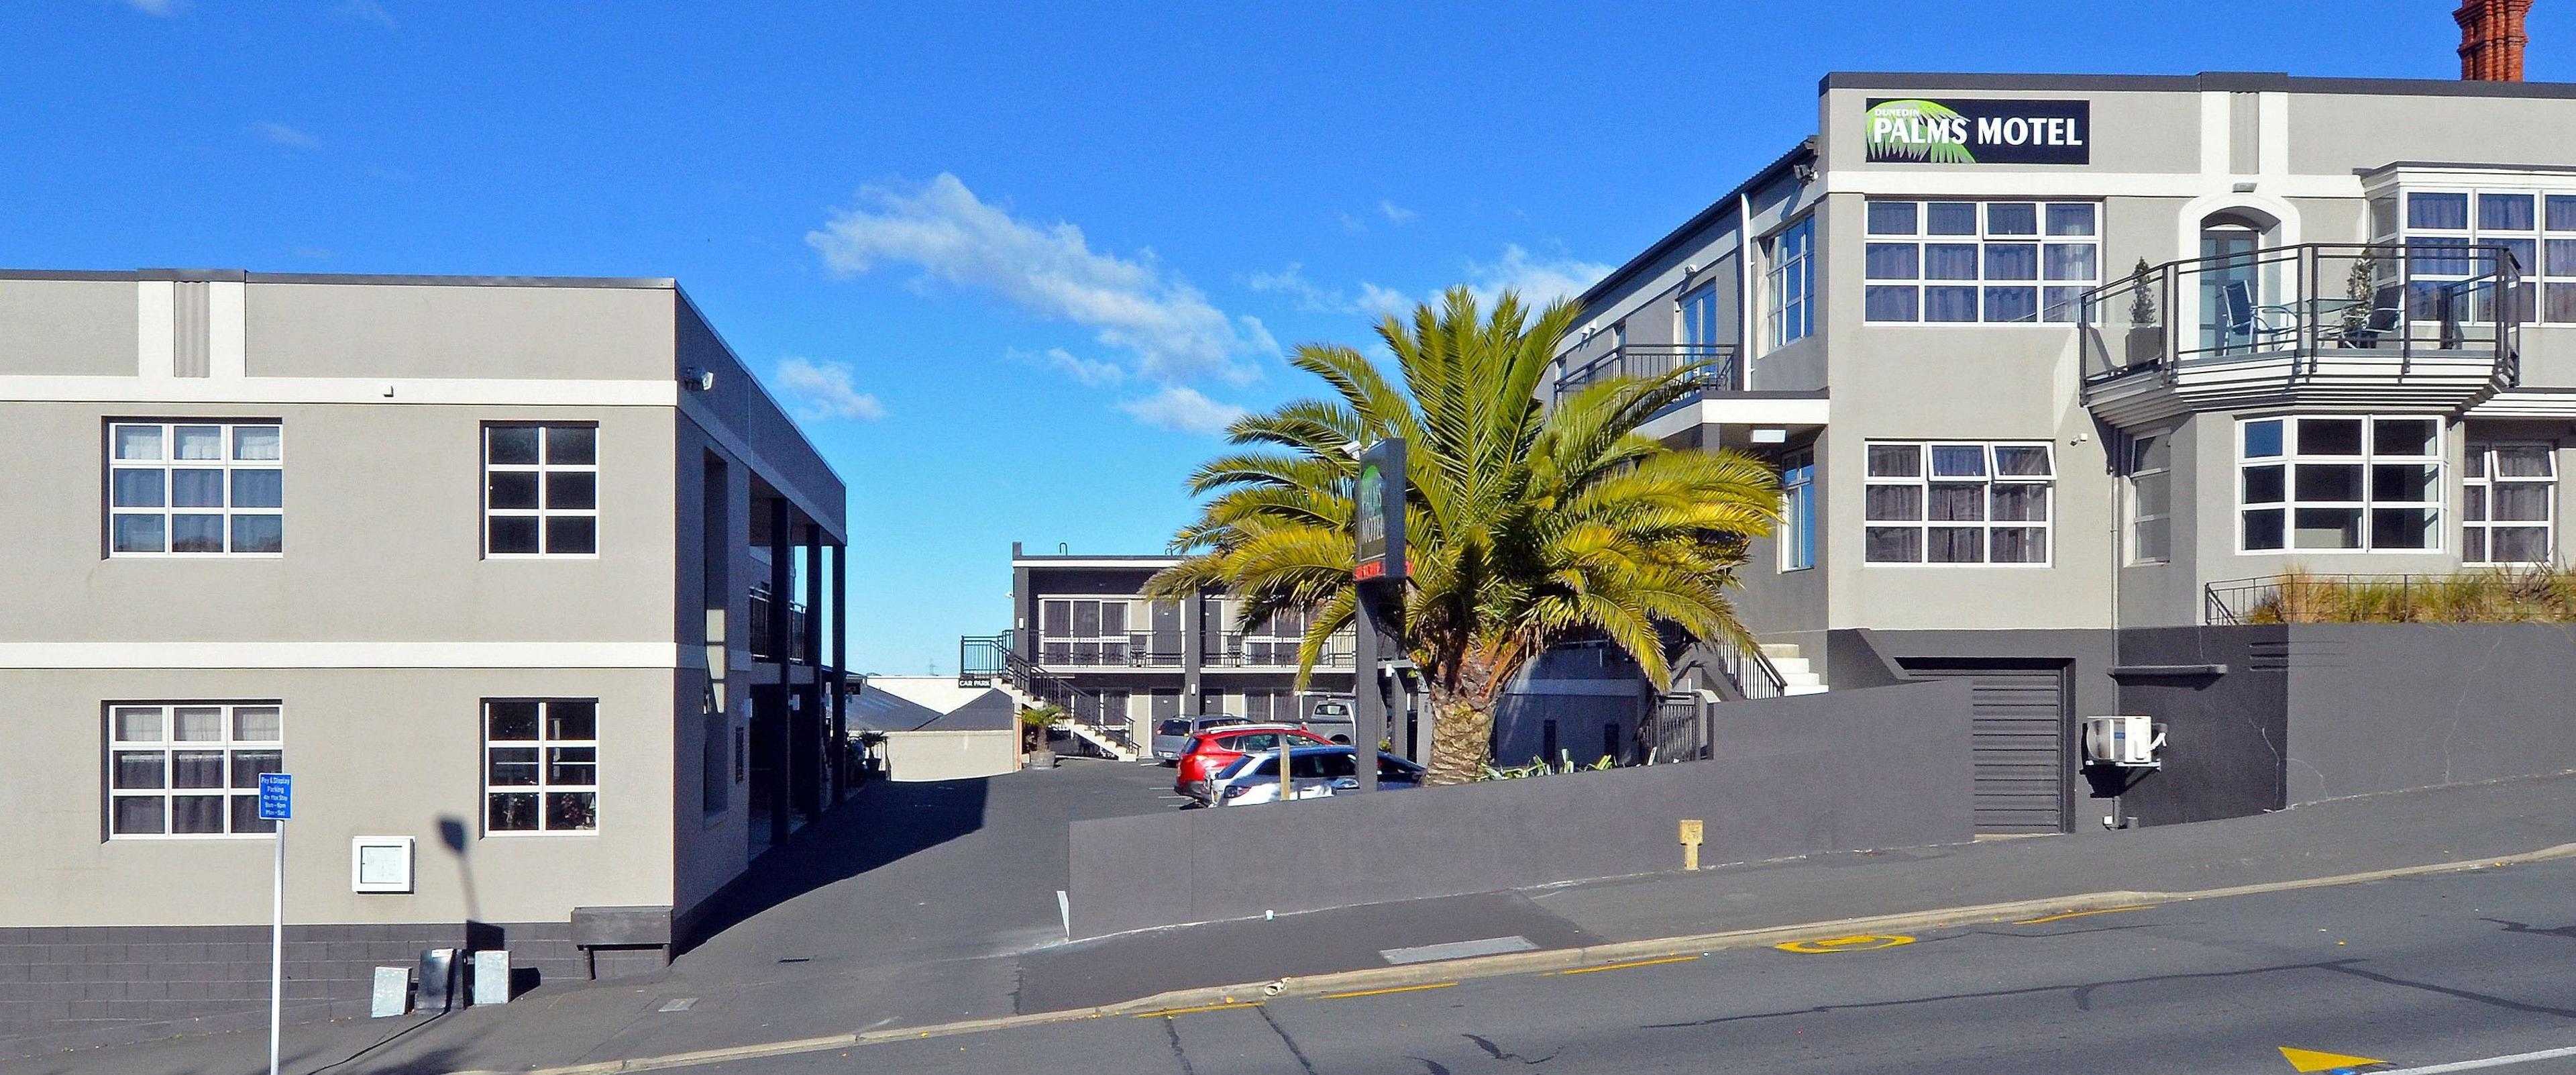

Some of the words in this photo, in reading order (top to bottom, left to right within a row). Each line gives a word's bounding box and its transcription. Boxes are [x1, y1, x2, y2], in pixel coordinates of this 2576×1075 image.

[1874, 109, 1921, 117] DUNEDIN
[1874, 117, 1968, 144] PALMS
[1978, 117, 2083, 146] MOTEL
[1362, 514, 1385, 543] MOTEL
[261, 776, 269, 784] Pay
[273, 777, 290, 785] Display
[267, 786, 284, 794] Parking
